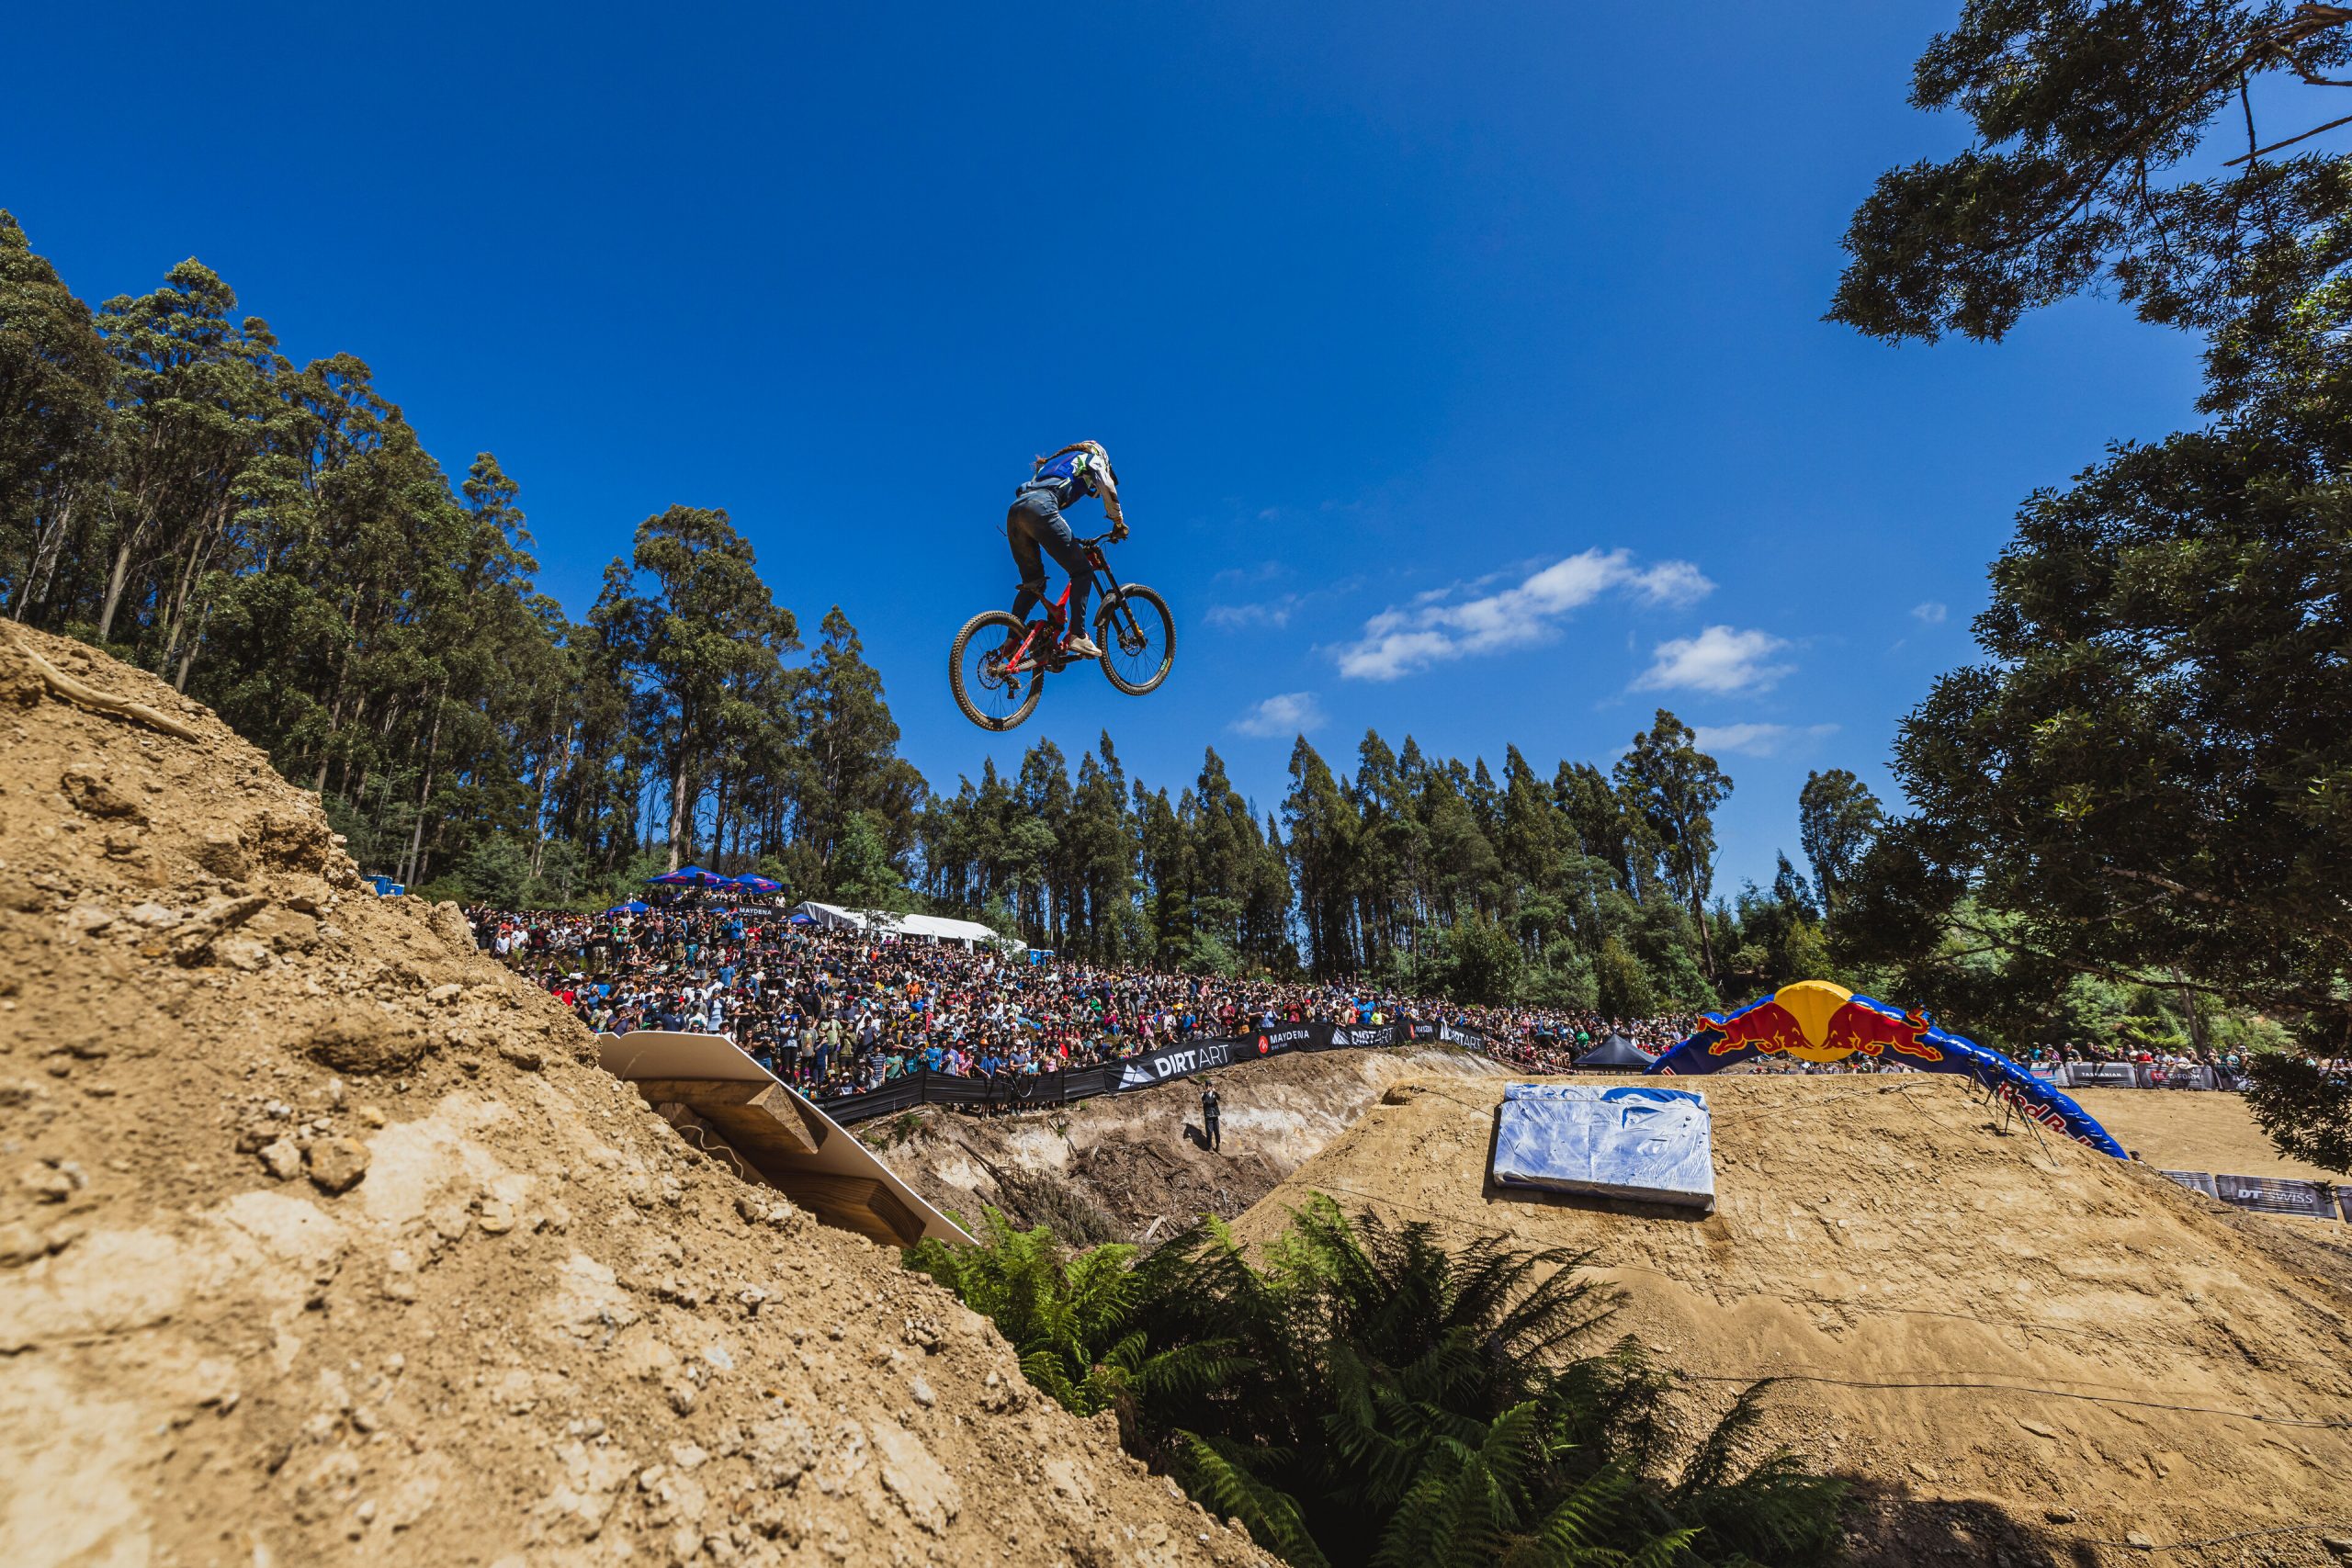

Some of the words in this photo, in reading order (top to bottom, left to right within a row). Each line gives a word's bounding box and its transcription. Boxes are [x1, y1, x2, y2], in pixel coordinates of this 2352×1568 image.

[739, 907, 772, 916] MAYDENA
[1270, 1030, 1310, 1044] MAYDENA
[1351, 1030, 1377, 1045] DIRT
[1154, 1050, 1196, 1077] DIRT
[1199, 1043, 1229, 1068] ART
[2238, 1189, 2263, 1200] DT
[2267, 1190, 2313, 1204] SWISS
